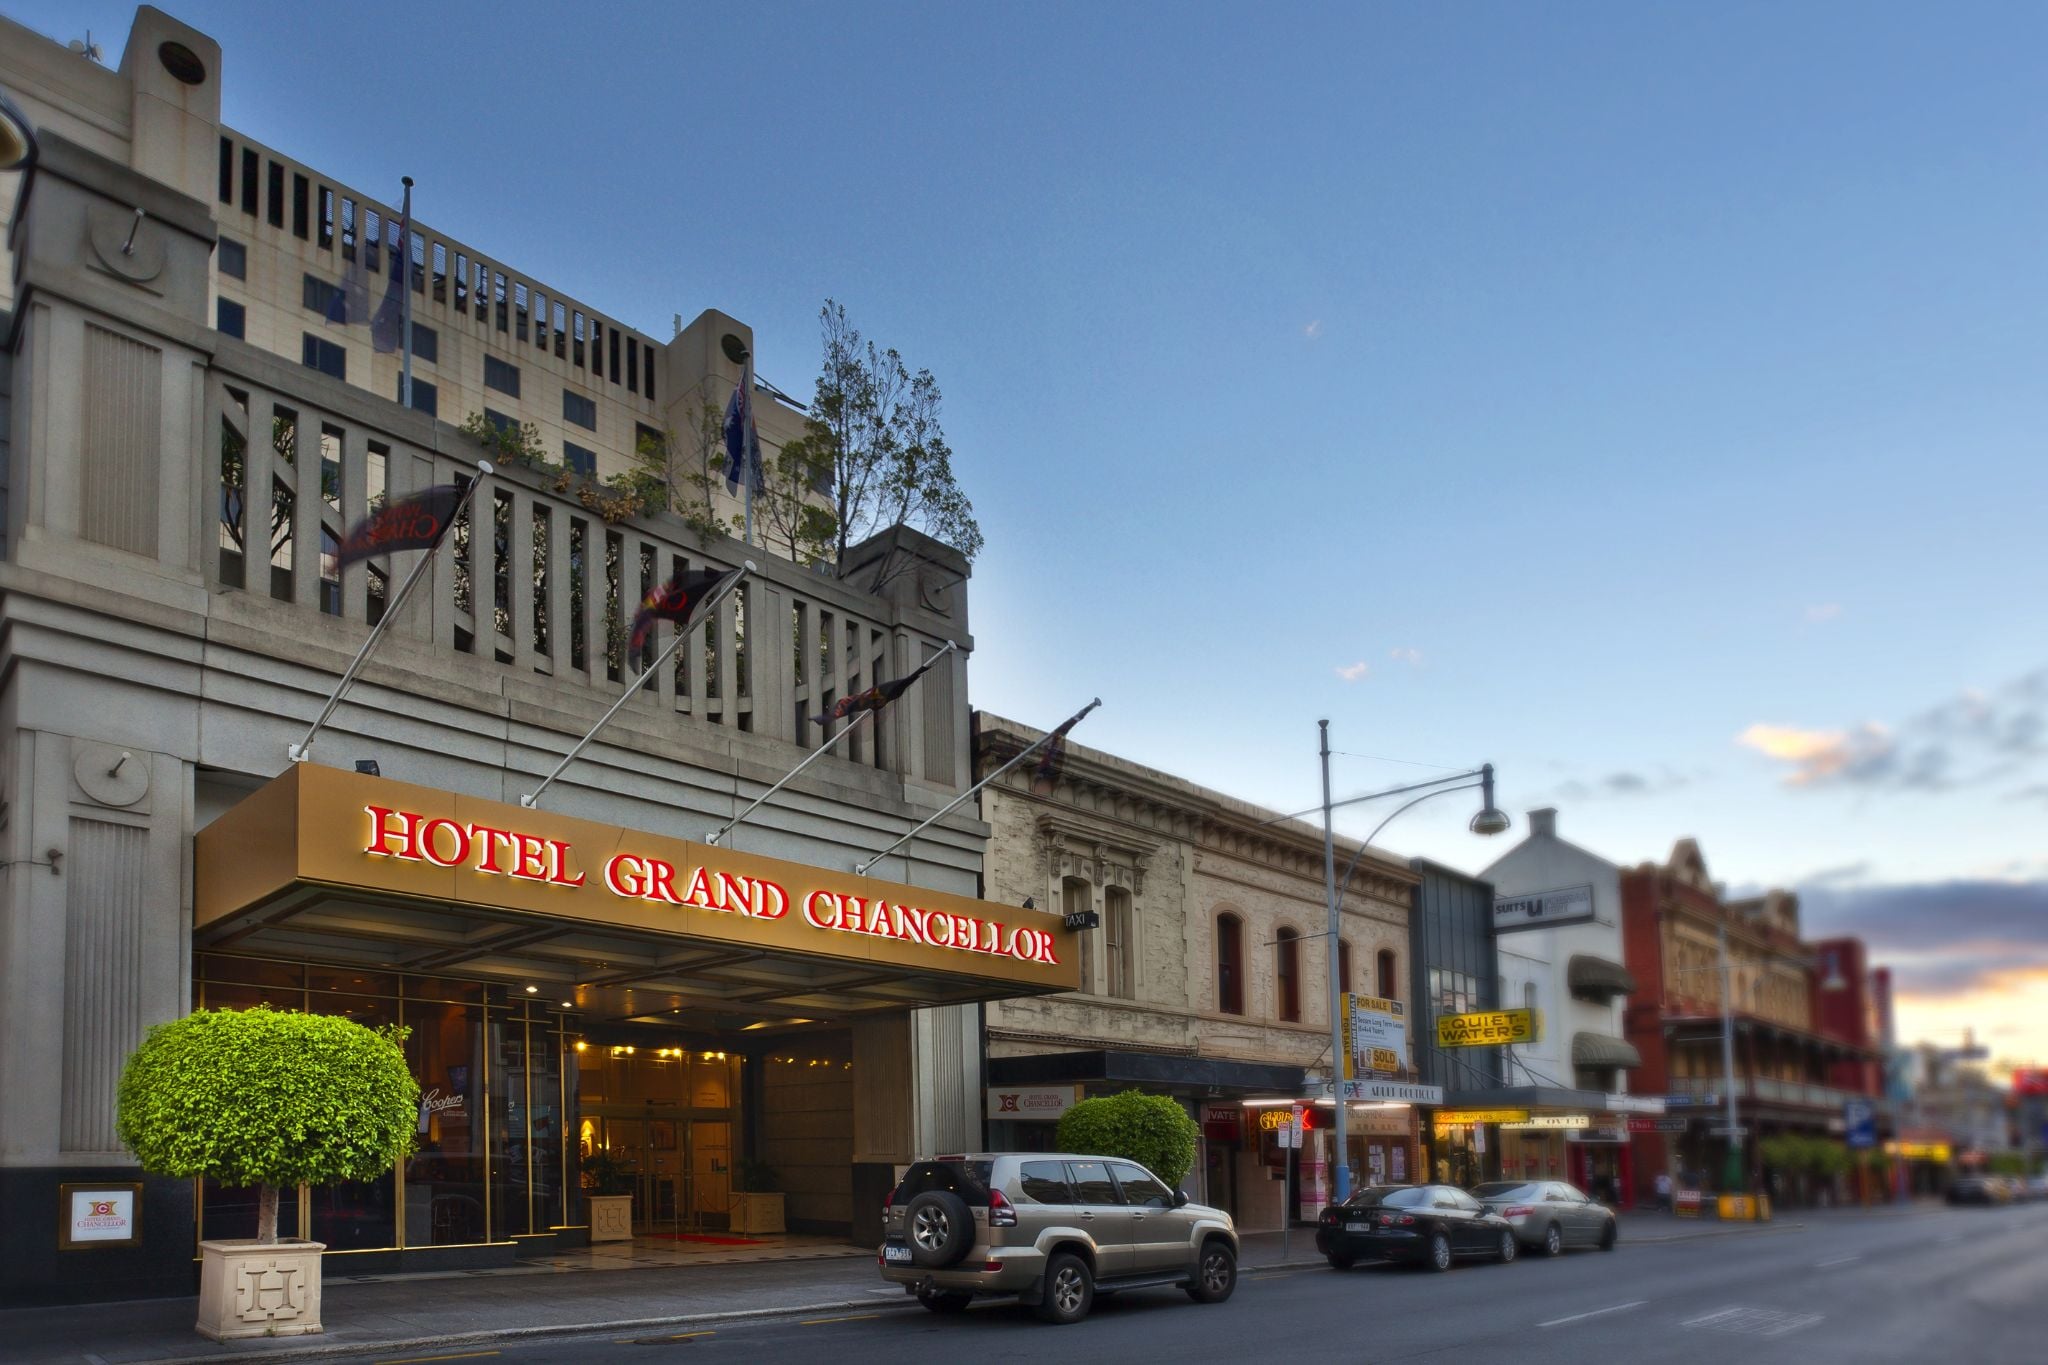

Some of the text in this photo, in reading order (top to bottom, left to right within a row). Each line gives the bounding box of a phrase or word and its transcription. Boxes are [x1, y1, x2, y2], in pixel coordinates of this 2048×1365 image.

[363, 805, 1061, 965] HOTEL GRAND CHANCELLOR
[1495, 902, 1526, 914] SUITS
[1065, 913, 1085, 928] TAXI
[1356, 998, 1370, 1009] FOR
[1371, 1001, 1388, 1011] SALE
[1372, 1018, 1382, 1027] Long
[1383, 1019, 1392, 1027] Term
[1451, 1014, 1518, 1029] QUIET
[1342, 1017, 1351, 1055] FOR SALE
[1441, 1025, 1526, 1041] WATERS
[1373, 1050, 1396, 1065] SOLD
[1370, 1085, 1396, 1098] ADULT
[422, 1088, 464, 1111] Coopers
[1023, 1098, 1064, 1108] CHANCELLOR
[1208, 1111, 1236, 1120] IVATE
[77, 1219, 127, 1228] CHANCELLOR
